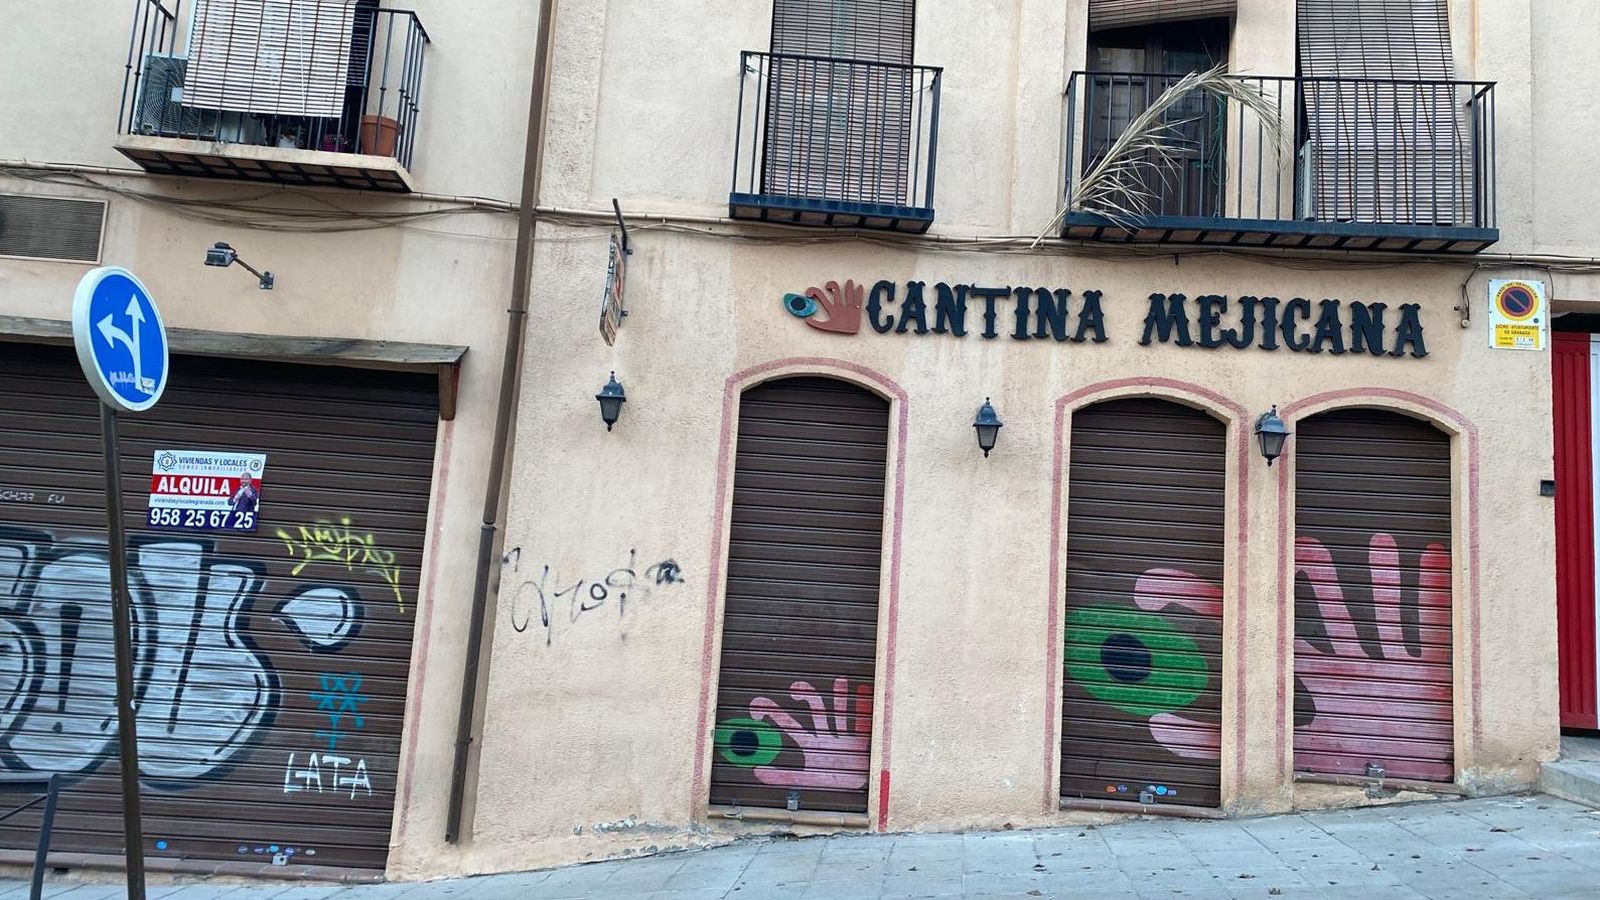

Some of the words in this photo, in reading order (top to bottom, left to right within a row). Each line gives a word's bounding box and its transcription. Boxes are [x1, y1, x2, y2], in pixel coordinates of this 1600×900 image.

[865, 280, 1109, 343] CANTINA
[1138, 292, 1430, 359] MEJICANA
[179, 457, 212, 465] VIVIENDAS
[220, 459, 248, 467] LOCALES
[157, 476, 231, 495] ALQUILA
[150, 508, 180, 526] 958
[184, 510, 206, 527] 25
[209, 511, 231, 528] 67
[233, 511, 254, 529] 25
[283, 752, 373, 800] LATA
